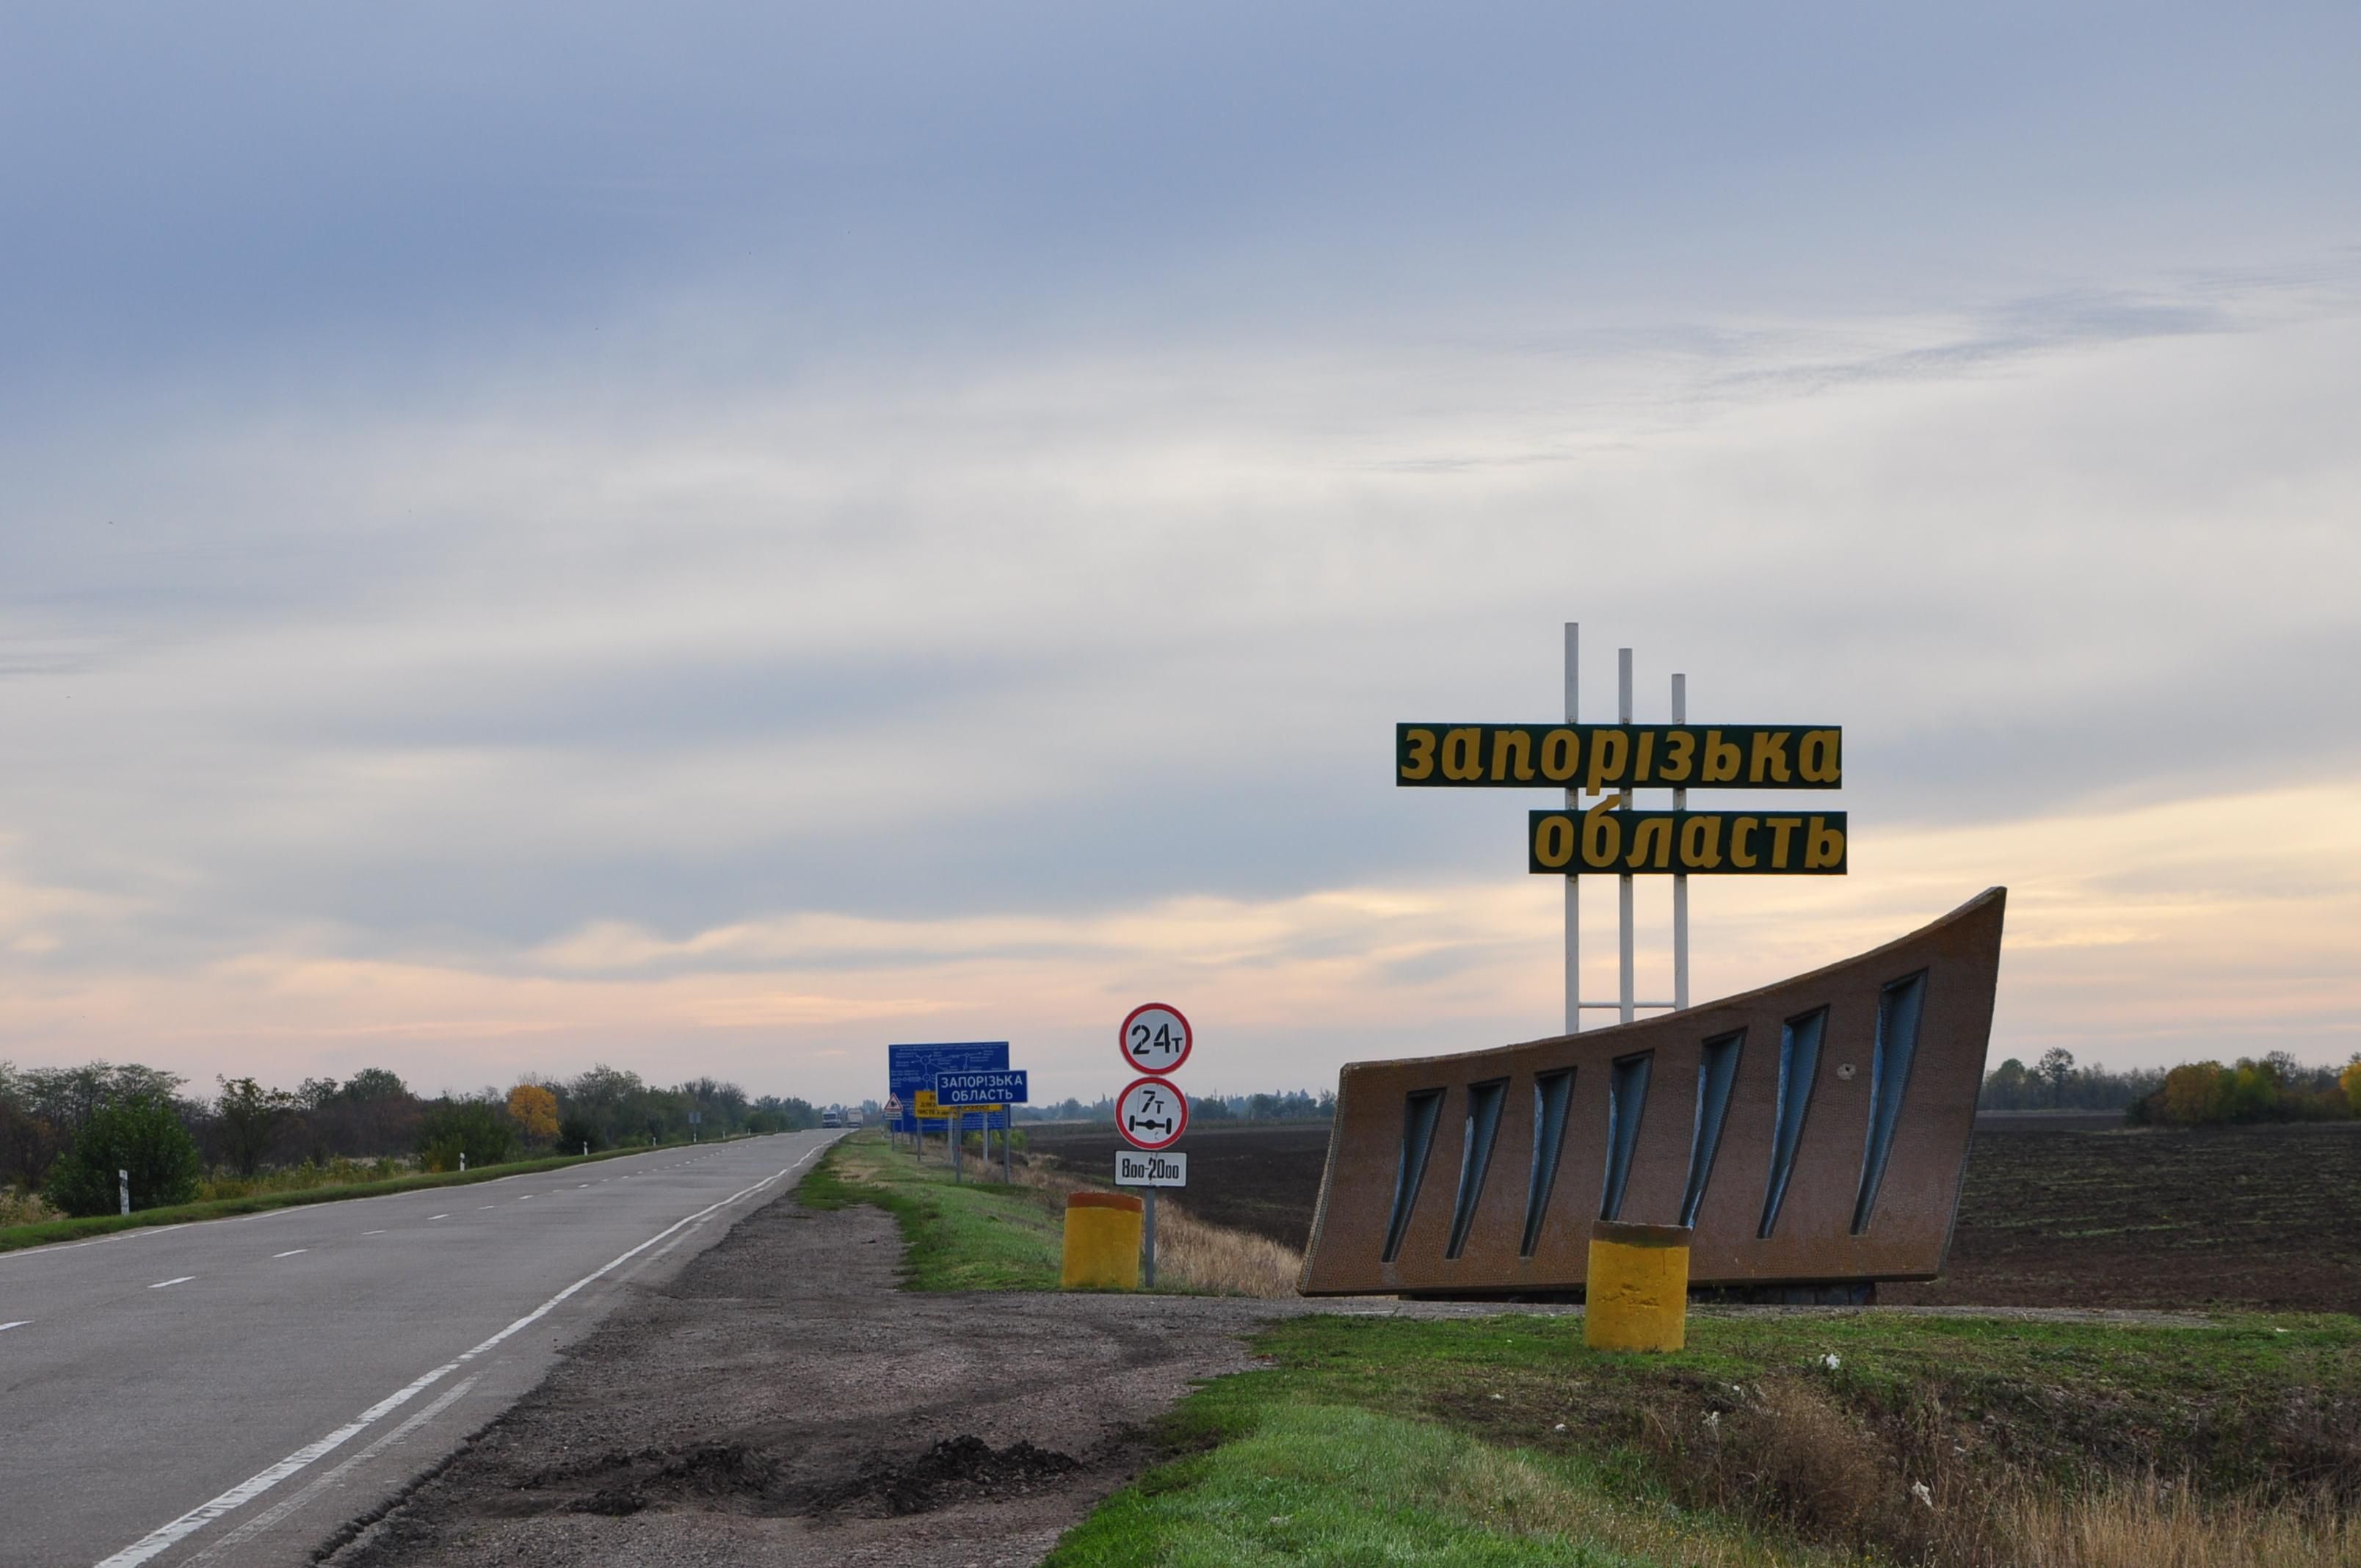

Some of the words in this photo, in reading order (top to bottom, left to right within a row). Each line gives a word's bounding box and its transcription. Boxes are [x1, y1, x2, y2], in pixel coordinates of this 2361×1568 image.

[1400, 727, 1842, 796] запорізька
[1534, 794, 1846, 869] область
[940, 1074, 1023, 1089] ЗАПОРІЗЬКА
[951, 1088, 1014, 1102] ОБЛАСТЬ
